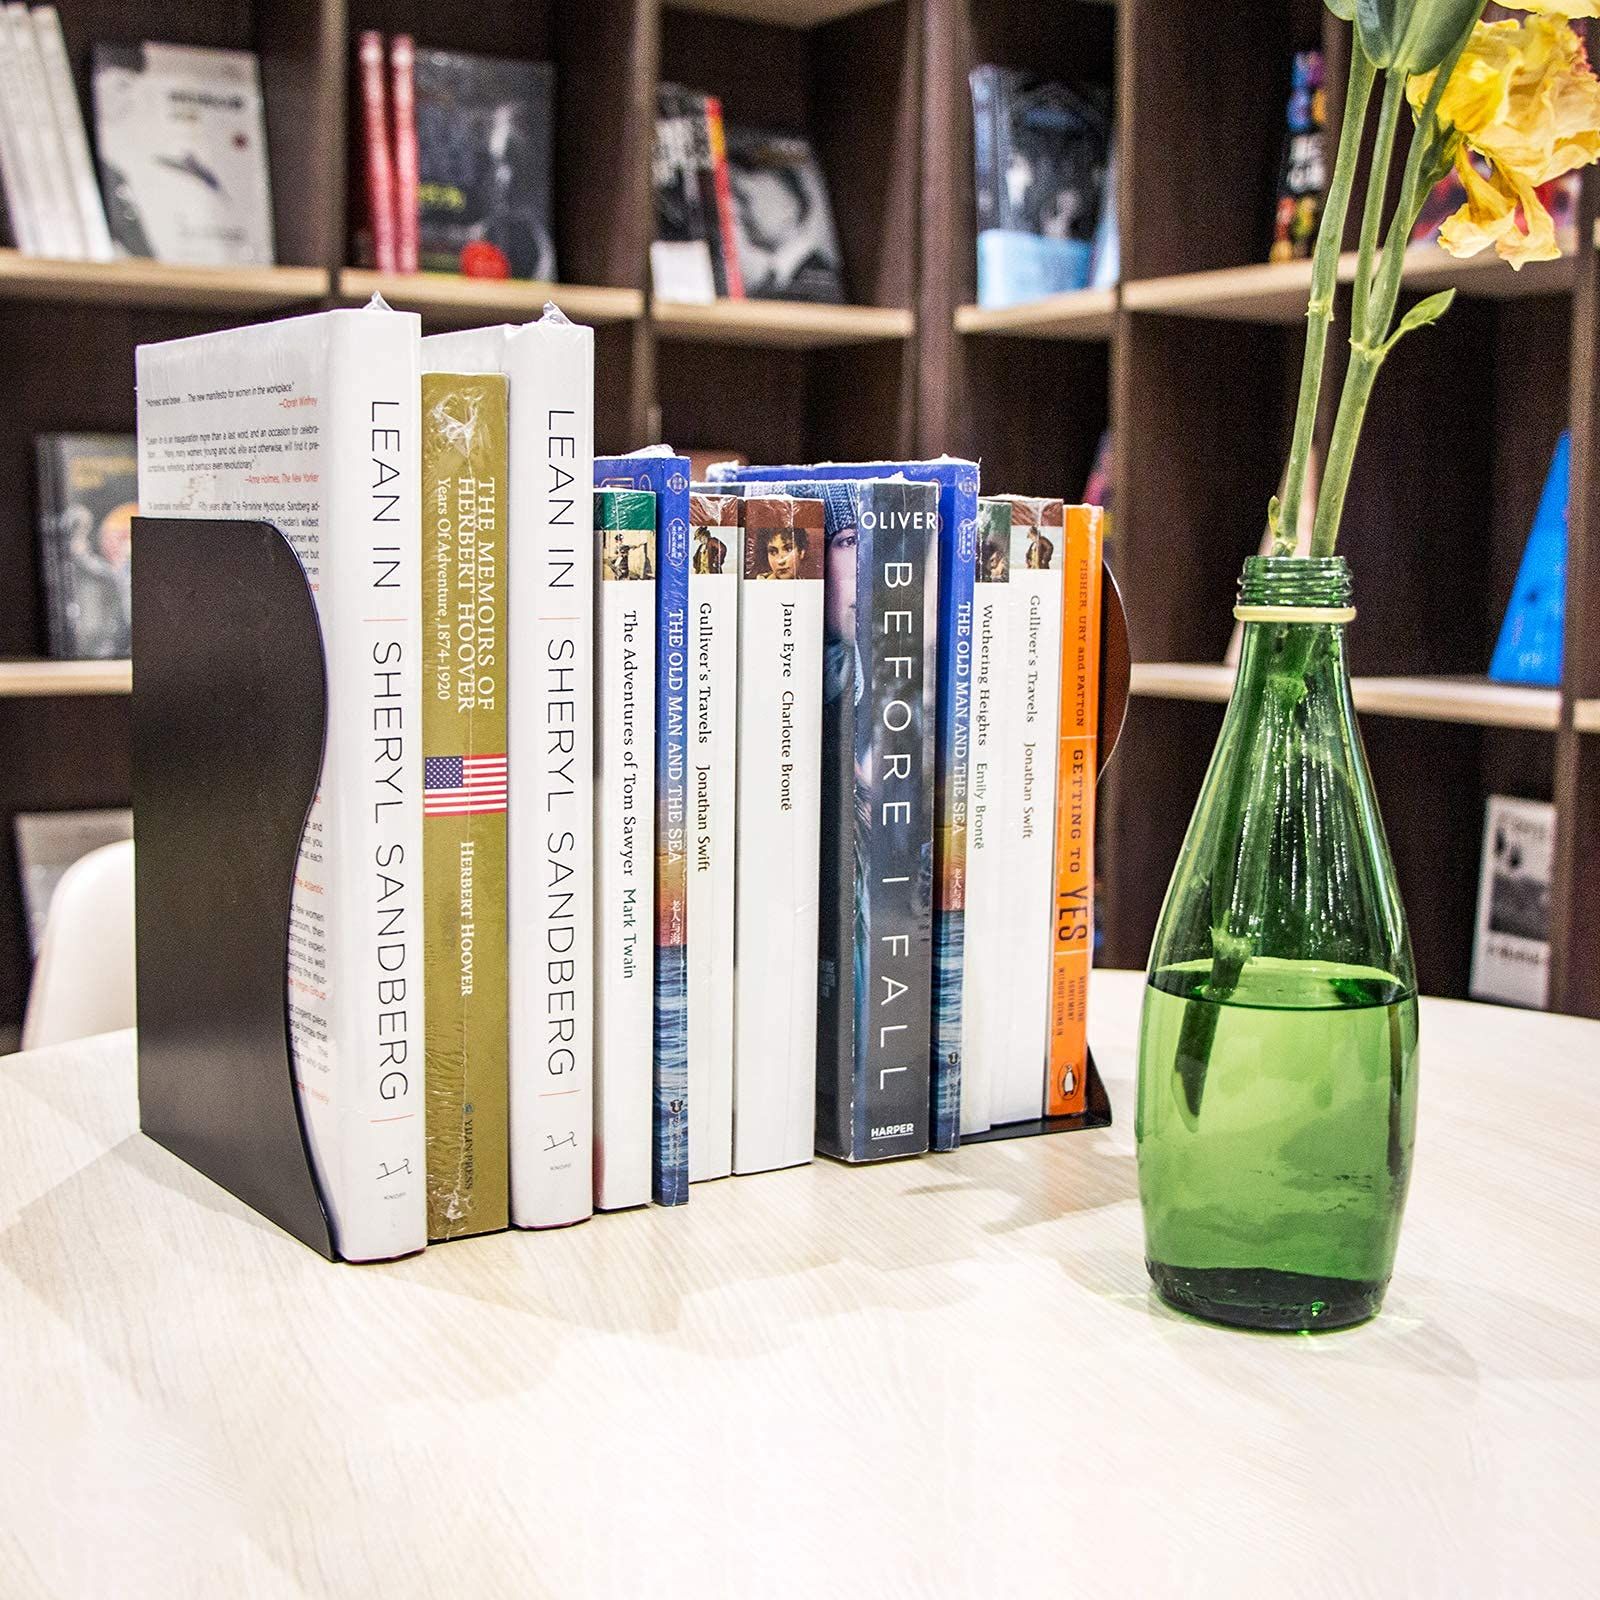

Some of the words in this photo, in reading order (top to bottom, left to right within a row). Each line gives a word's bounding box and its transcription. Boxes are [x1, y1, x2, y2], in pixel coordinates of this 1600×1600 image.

[235, 389, 251, 398] women
[371, 401, 401, 522] LEAN
[548, 410, 575, 525] LEAN
[437, 478, 451, 519] Years
[477, 477, 495, 531] THE
[457, 477, 475, 594] HERBERT
[860, 511, 937, 530] OLIVER
[372, 547, 401, 588] IN
[548, 549, 575, 588] IN
[477, 541, 495, 667] MEMOIRS
[780, 602, 795, 637] Jane
[957, 601, 971, 636] THE
[623, 610, 638, 643] The
[668, 608, 684, 648] THE
[699, 602, 713, 682] Gulliver's
[977, 604, 993, 684] Wuthering
[1028, 595, 1041, 666] Gulliver's
[1079, 616, 1087, 646] URY
[437, 624, 451, 700] 1874-1920
[457, 601, 475, 713] HOOVER
[668, 653, 684, 689] OLD
[779, 643, 795, 678] Eyre
[956, 640, 970, 676] OLD
[1078, 648, 1088, 671] and
[477, 676, 495, 710] OF
[623, 648, 638, 745] Adventures
[882, 562, 913, 826] BEFORE
[955, 682, 970, 717] MAN
[1026, 671, 1038, 723] Travels
[1076, 676, 1086, 727] PATTON
[372, 641, 403, 824] SHERYL
[547, 639, 575, 812] SHERYL
[668, 696, 684, 736] MAN
[698, 686, 713, 744] Travels
[781, 690, 794, 758] Charlotte
[976, 689, 991, 747] Heights
[623, 751, 639, 770] of
[668, 741, 683, 780] AND
[954, 722, 968, 758] AND
[623, 773, 637, 810] Tom
[780, 763, 794, 811] Brontë
[953, 763, 967, 795] THE
[973, 762, 987, 800] Emily
[1023, 742, 1036, 801] Jonathan
[668, 785, 682, 824] THE
[696, 764, 711, 830] Jonathan
[1070, 749, 1084, 840] GETTING
[953, 801, 966, 834] SEA
[973, 805, 987, 850] Brontë
[1022, 806, 1034, 839] Swift
[619, 816, 637, 876] Sawyer
[667, 829, 682, 864] SEA
[697, 835, 711, 872] Swift
[1069, 846, 1082, 874] TO
[882, 875, 910, 884] I
[623, 888, 637, 927] Mark
[1058, 884, 1088, 942] YES
[375, 844, 409, 1101] SANDBERG
[547, 831, 575, 1076] SANDBERG
[623, 935, 637, 979] Twain
[879, 934, 909, 1090] FALL
[871, 1123, 914, 1137] HARPER
[464, 1155, 473, 1190] PRESS
